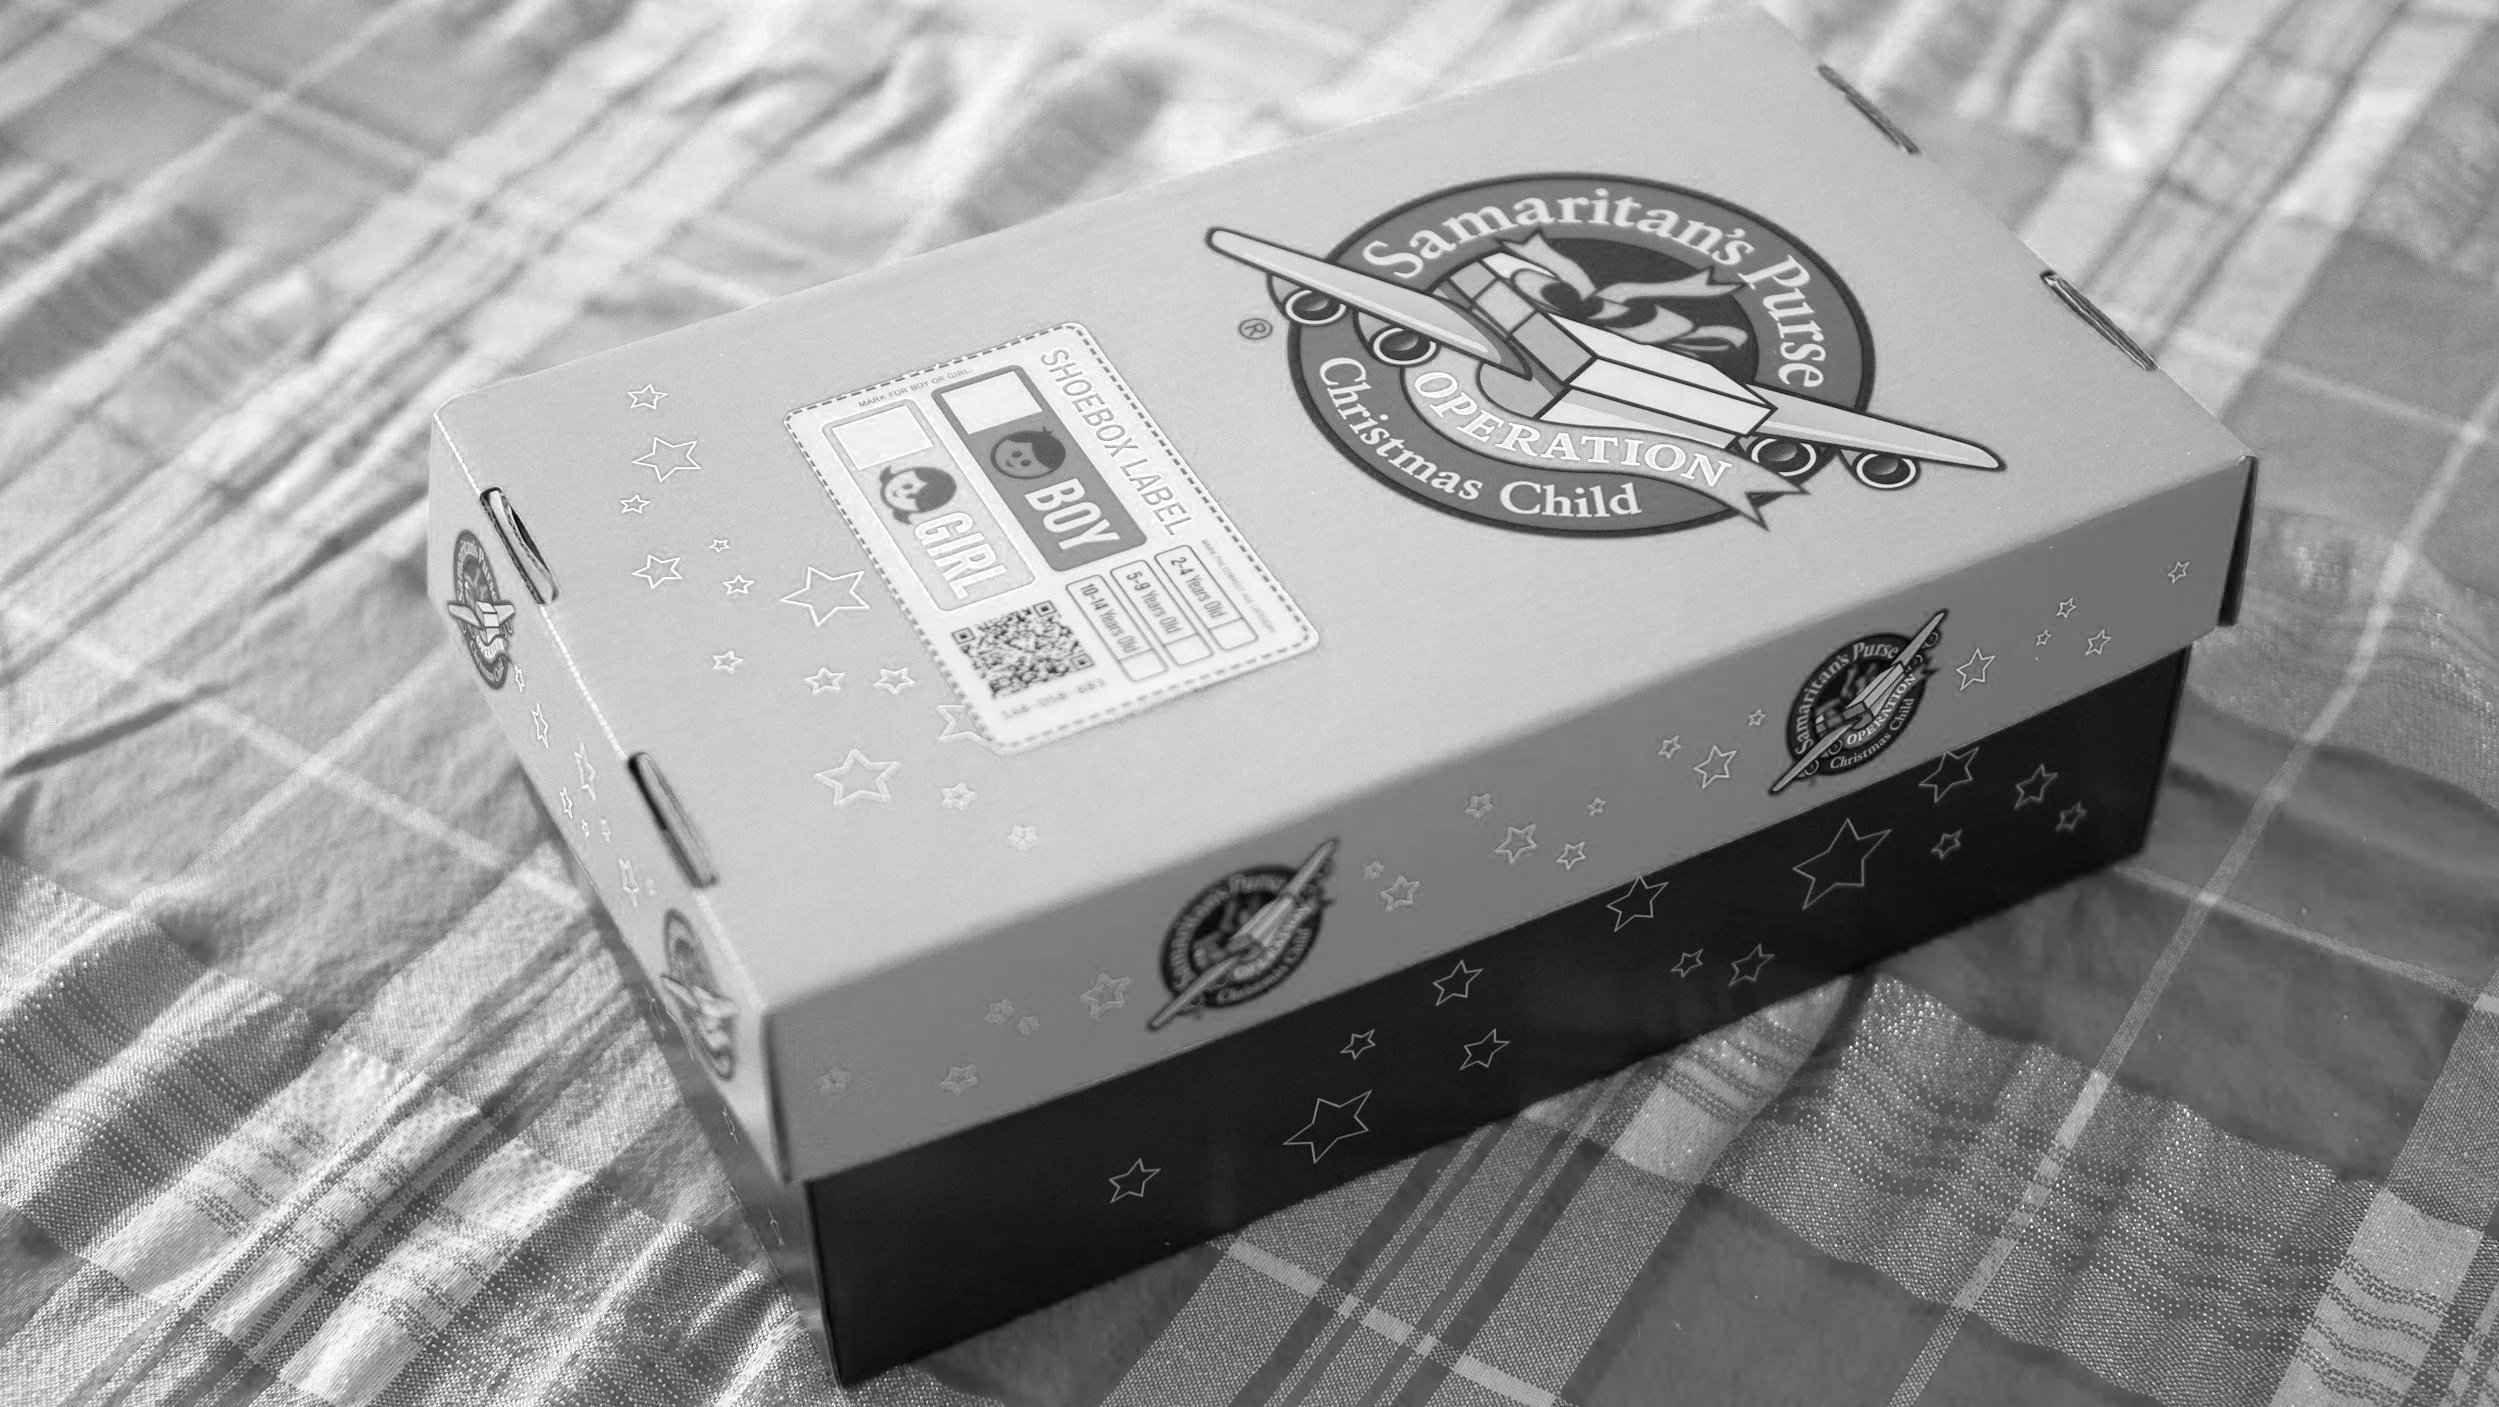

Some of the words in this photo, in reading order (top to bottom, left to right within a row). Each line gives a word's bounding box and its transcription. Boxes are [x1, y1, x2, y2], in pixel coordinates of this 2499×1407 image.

[1362, 188, 1755, 279] Samaritan's
[1738, 254, 1827, 389] Purse
[858, 393, 888, 408] MARK
[888, 387, 909, 399] FOR
[910, 380, 930, 391] BOY
[931, 374, 946, 384] OR
[1040, 349, 1139, 458] SHOEBOX
[1120, 457, 1193, 536] LABEL
[1319, 357, 1484, 500] Christmas
[1500, 481, 1642, 518] Child
[1414, 371, 1732, 487] OPERATION
[1024, 477, 1121, 551] BOY
[914, 511, 1008, 600] GIRL
[1170, 556, 1195, 576] 2-4
[1185, 574, 1211, 602] Years
[1203, 600, 1228, 619] Old
[1080, 583, 1110, 611] 10-14
[1100, 608, 1125, 637] Years
[1117, 635, 1142, 654] Old
[1126, 571, 1151, 592] 5-9
[1141, 589, 1167, 618] Years
[1159, 616, 1185, 634] Old
[1795, 652, 1849, 754] Samaritan's
[1852, 642, 1900, 660] Purse
[1830, 733, 1891, 769] Christmas
[1889, 698, 1915, 731] Child
[1847, 674, 1916, 745] OPERATION
